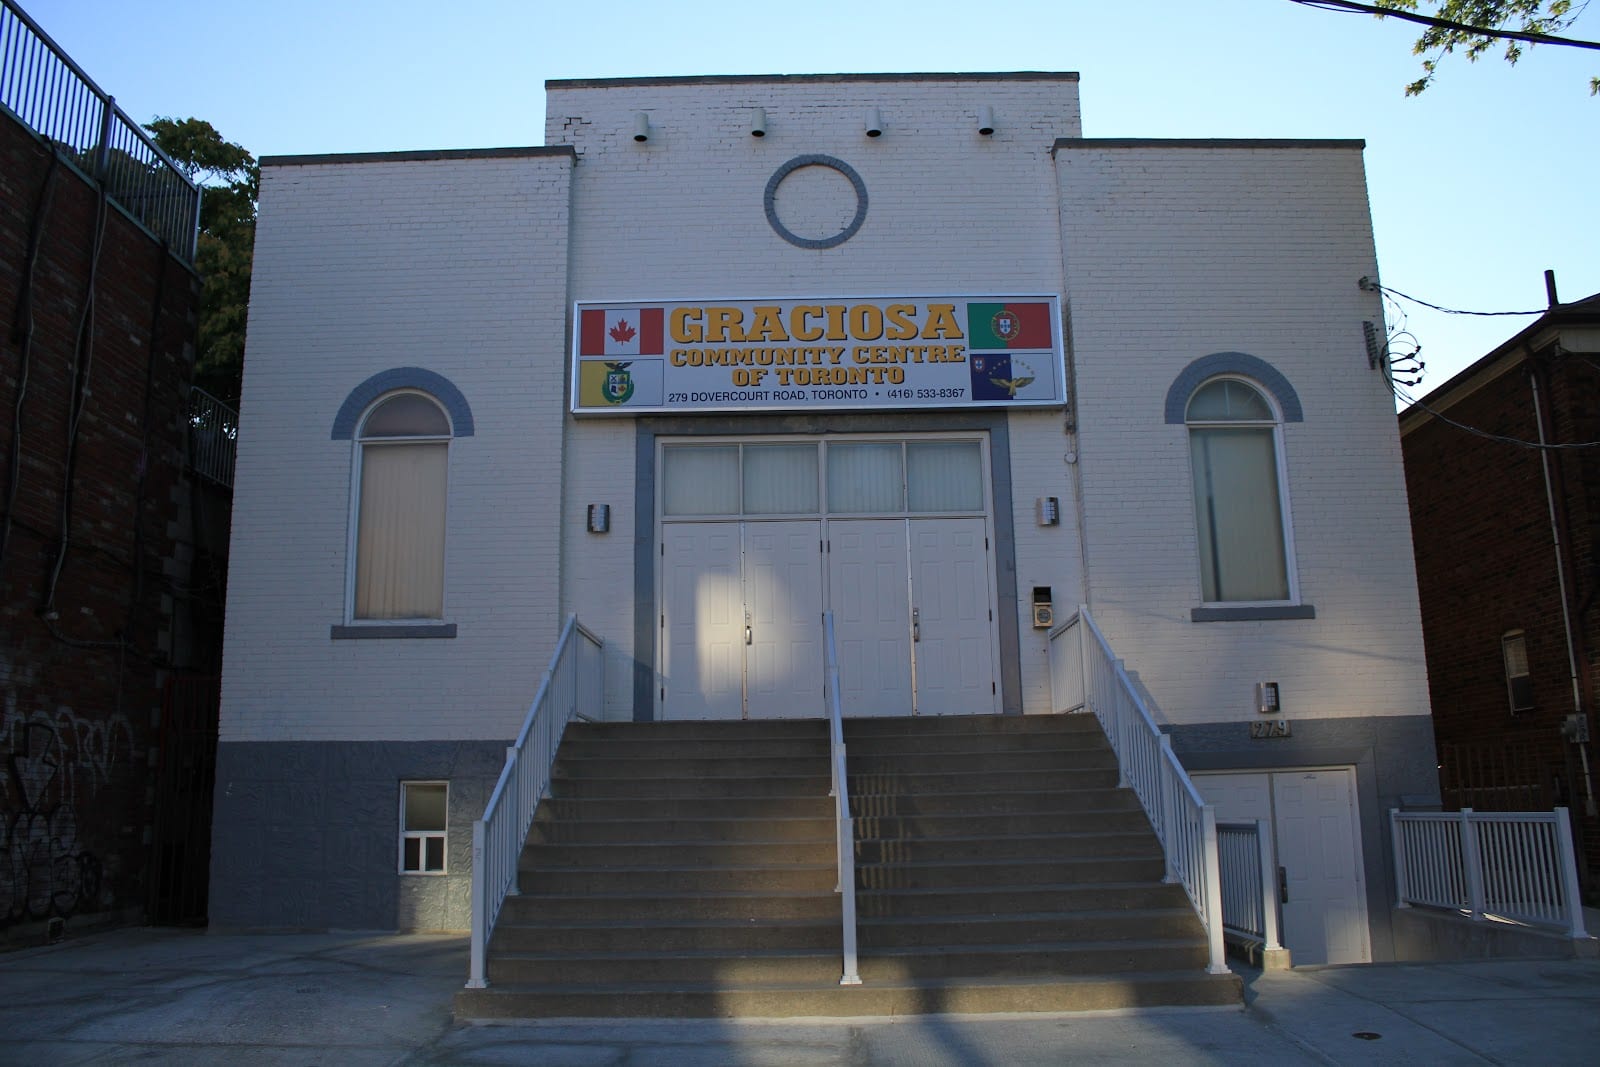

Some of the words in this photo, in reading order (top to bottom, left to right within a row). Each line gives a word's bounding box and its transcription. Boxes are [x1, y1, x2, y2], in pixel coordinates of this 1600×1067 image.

[670, 304, 965, 344] GRACIOSA
[670, 346, 845, 367] COMMUNITY
[852, 345, 966, 364] CENTRE
[732, 368, 769, 387] OF
[775, 366, 905, 386] TORONTO
[668, 393, 688, 403] 279
[691, 391, 769, 402] DOVERCOURT
[811, 389, 868, 400] TORONTO
[887, 389, 914, 399] (416)
[917, 388, 965, 399] 533-8367
[1251, 720, 1288, 737] 279
